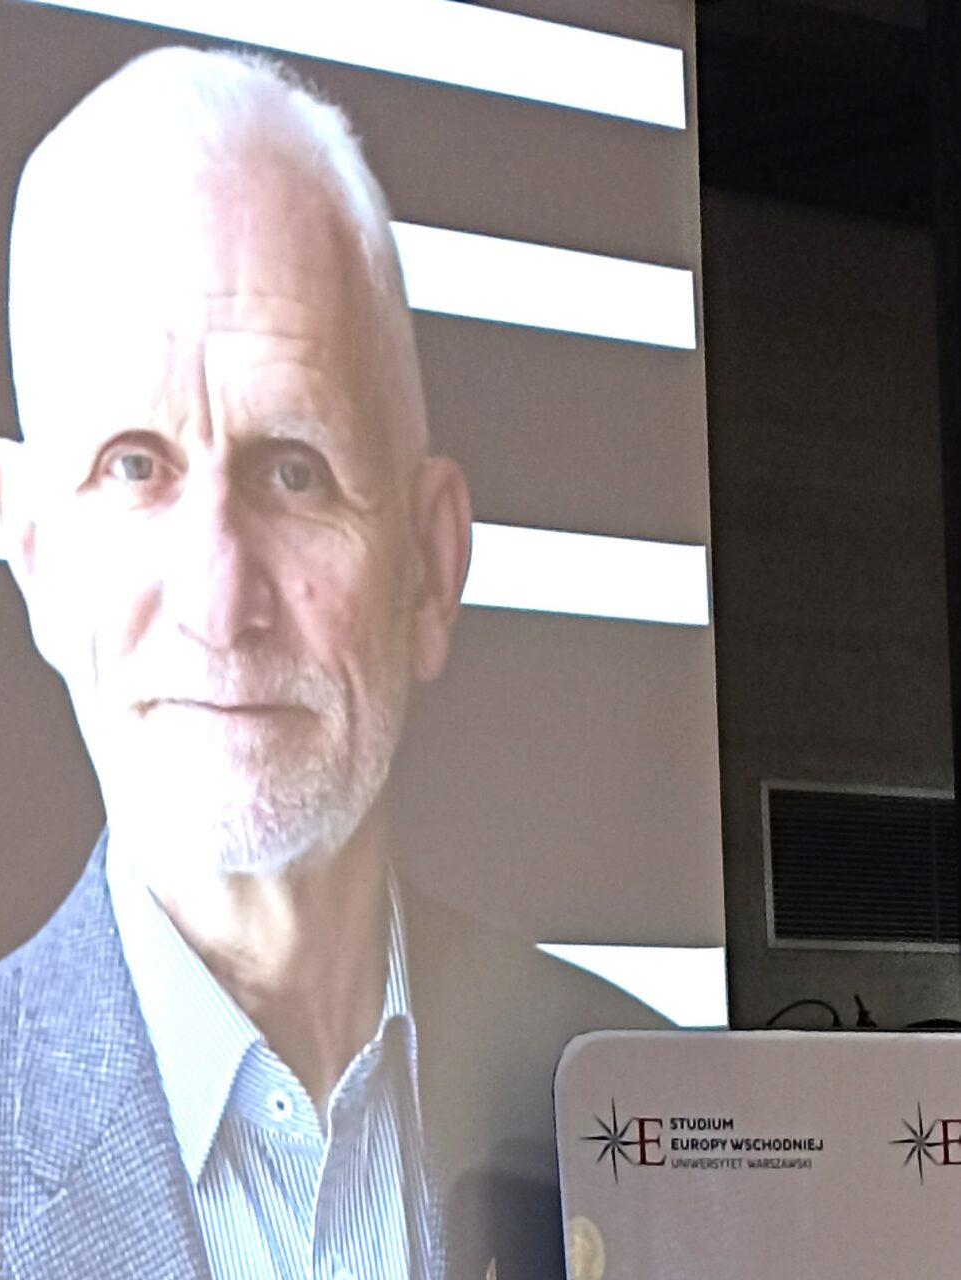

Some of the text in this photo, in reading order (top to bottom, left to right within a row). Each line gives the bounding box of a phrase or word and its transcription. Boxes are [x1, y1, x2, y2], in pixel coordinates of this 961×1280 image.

[669, 1117, 734, 1131] STUDIUM
[670, 1137, 824, 1151] EUROPY WSCHODNIEJ
[671, 1157, 813, 1170] UNIWERSYTET WARSZAWSKI
